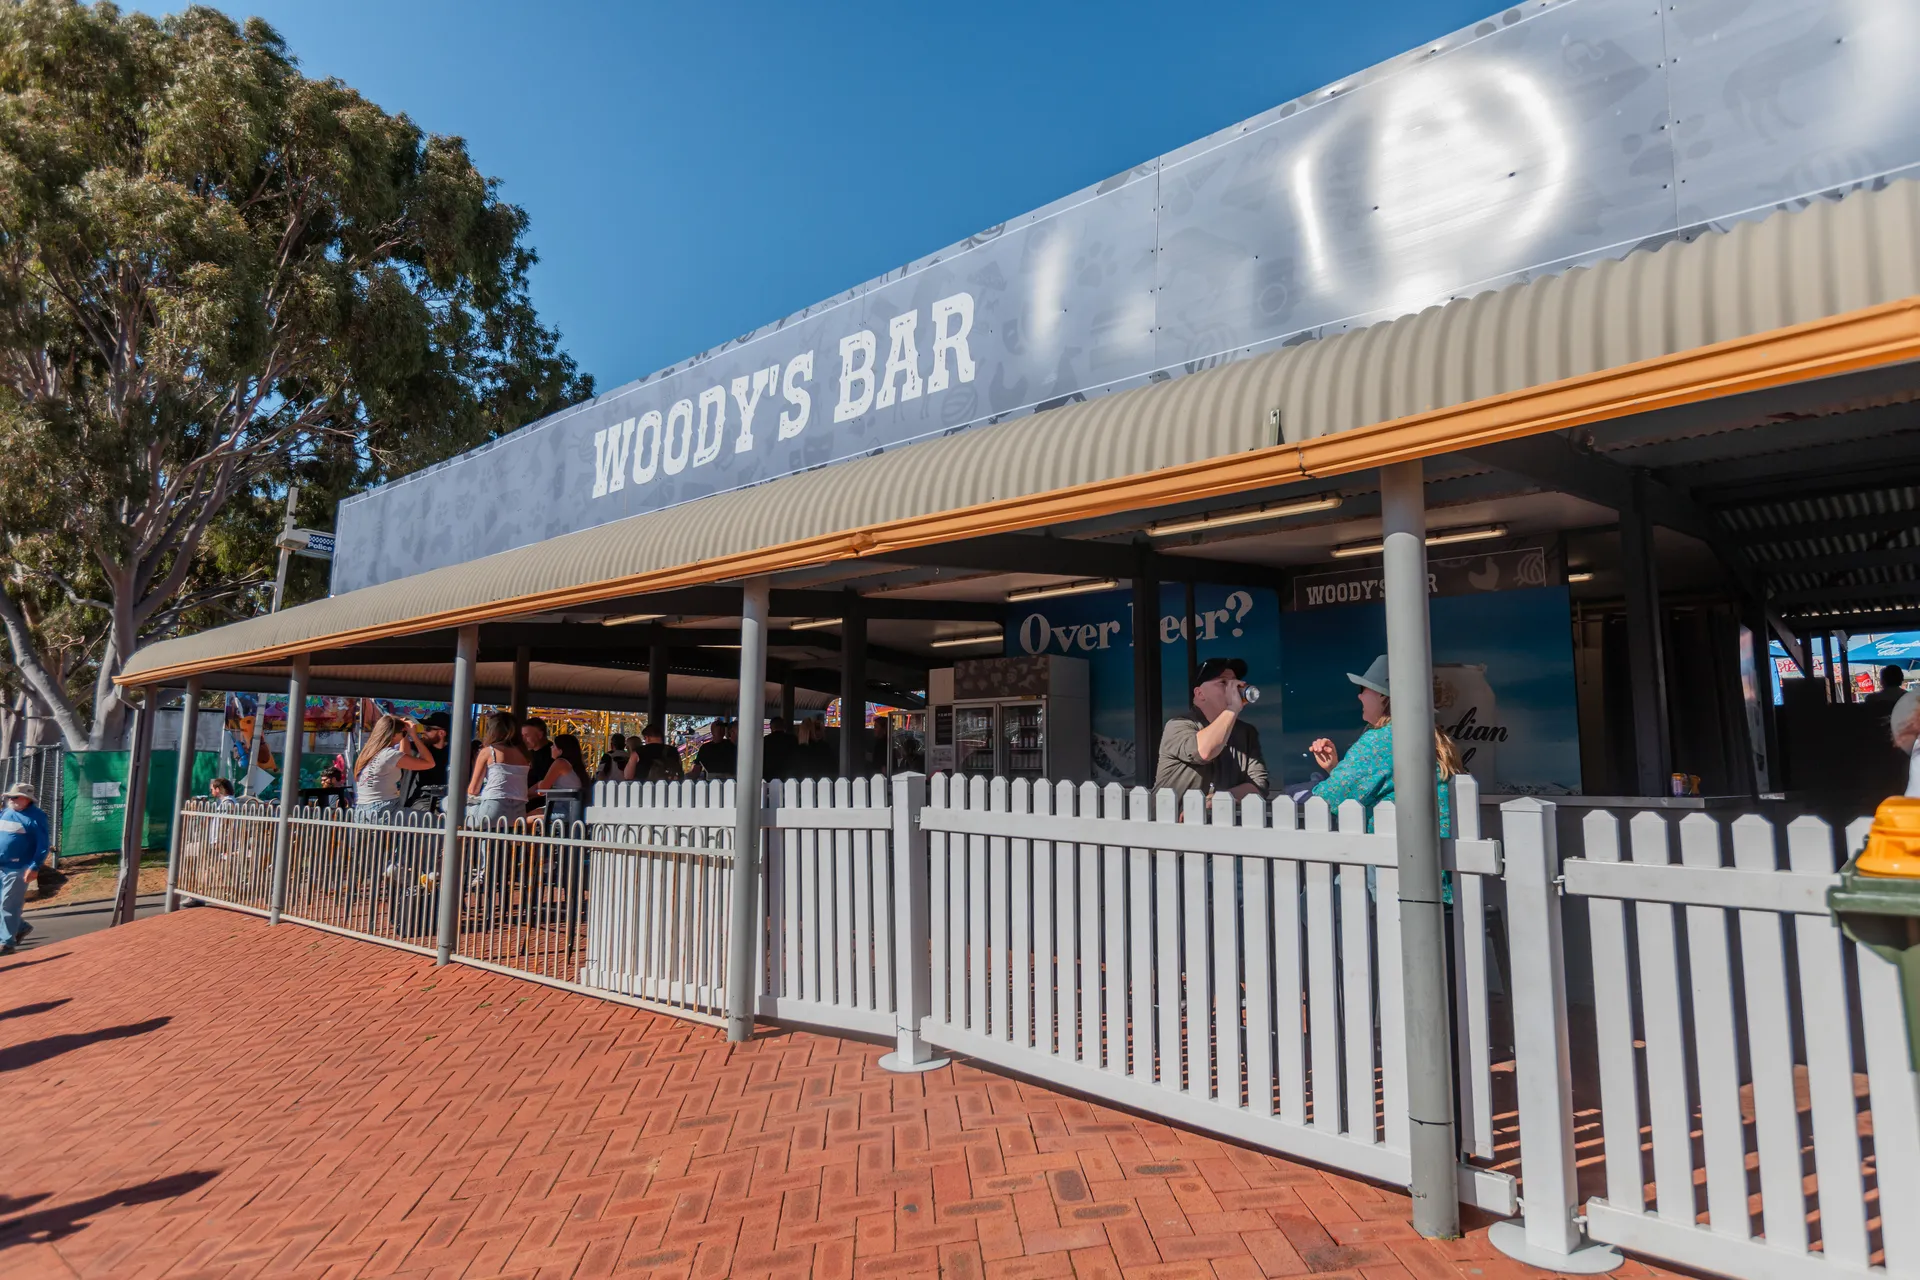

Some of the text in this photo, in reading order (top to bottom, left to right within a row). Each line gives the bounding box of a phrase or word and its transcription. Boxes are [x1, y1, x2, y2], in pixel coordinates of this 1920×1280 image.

[592, 292, 976, 499] WOODY'S BAR
[308, 542, 332, 551] Police
[1019, 590, 1254, 655] Over eer?
